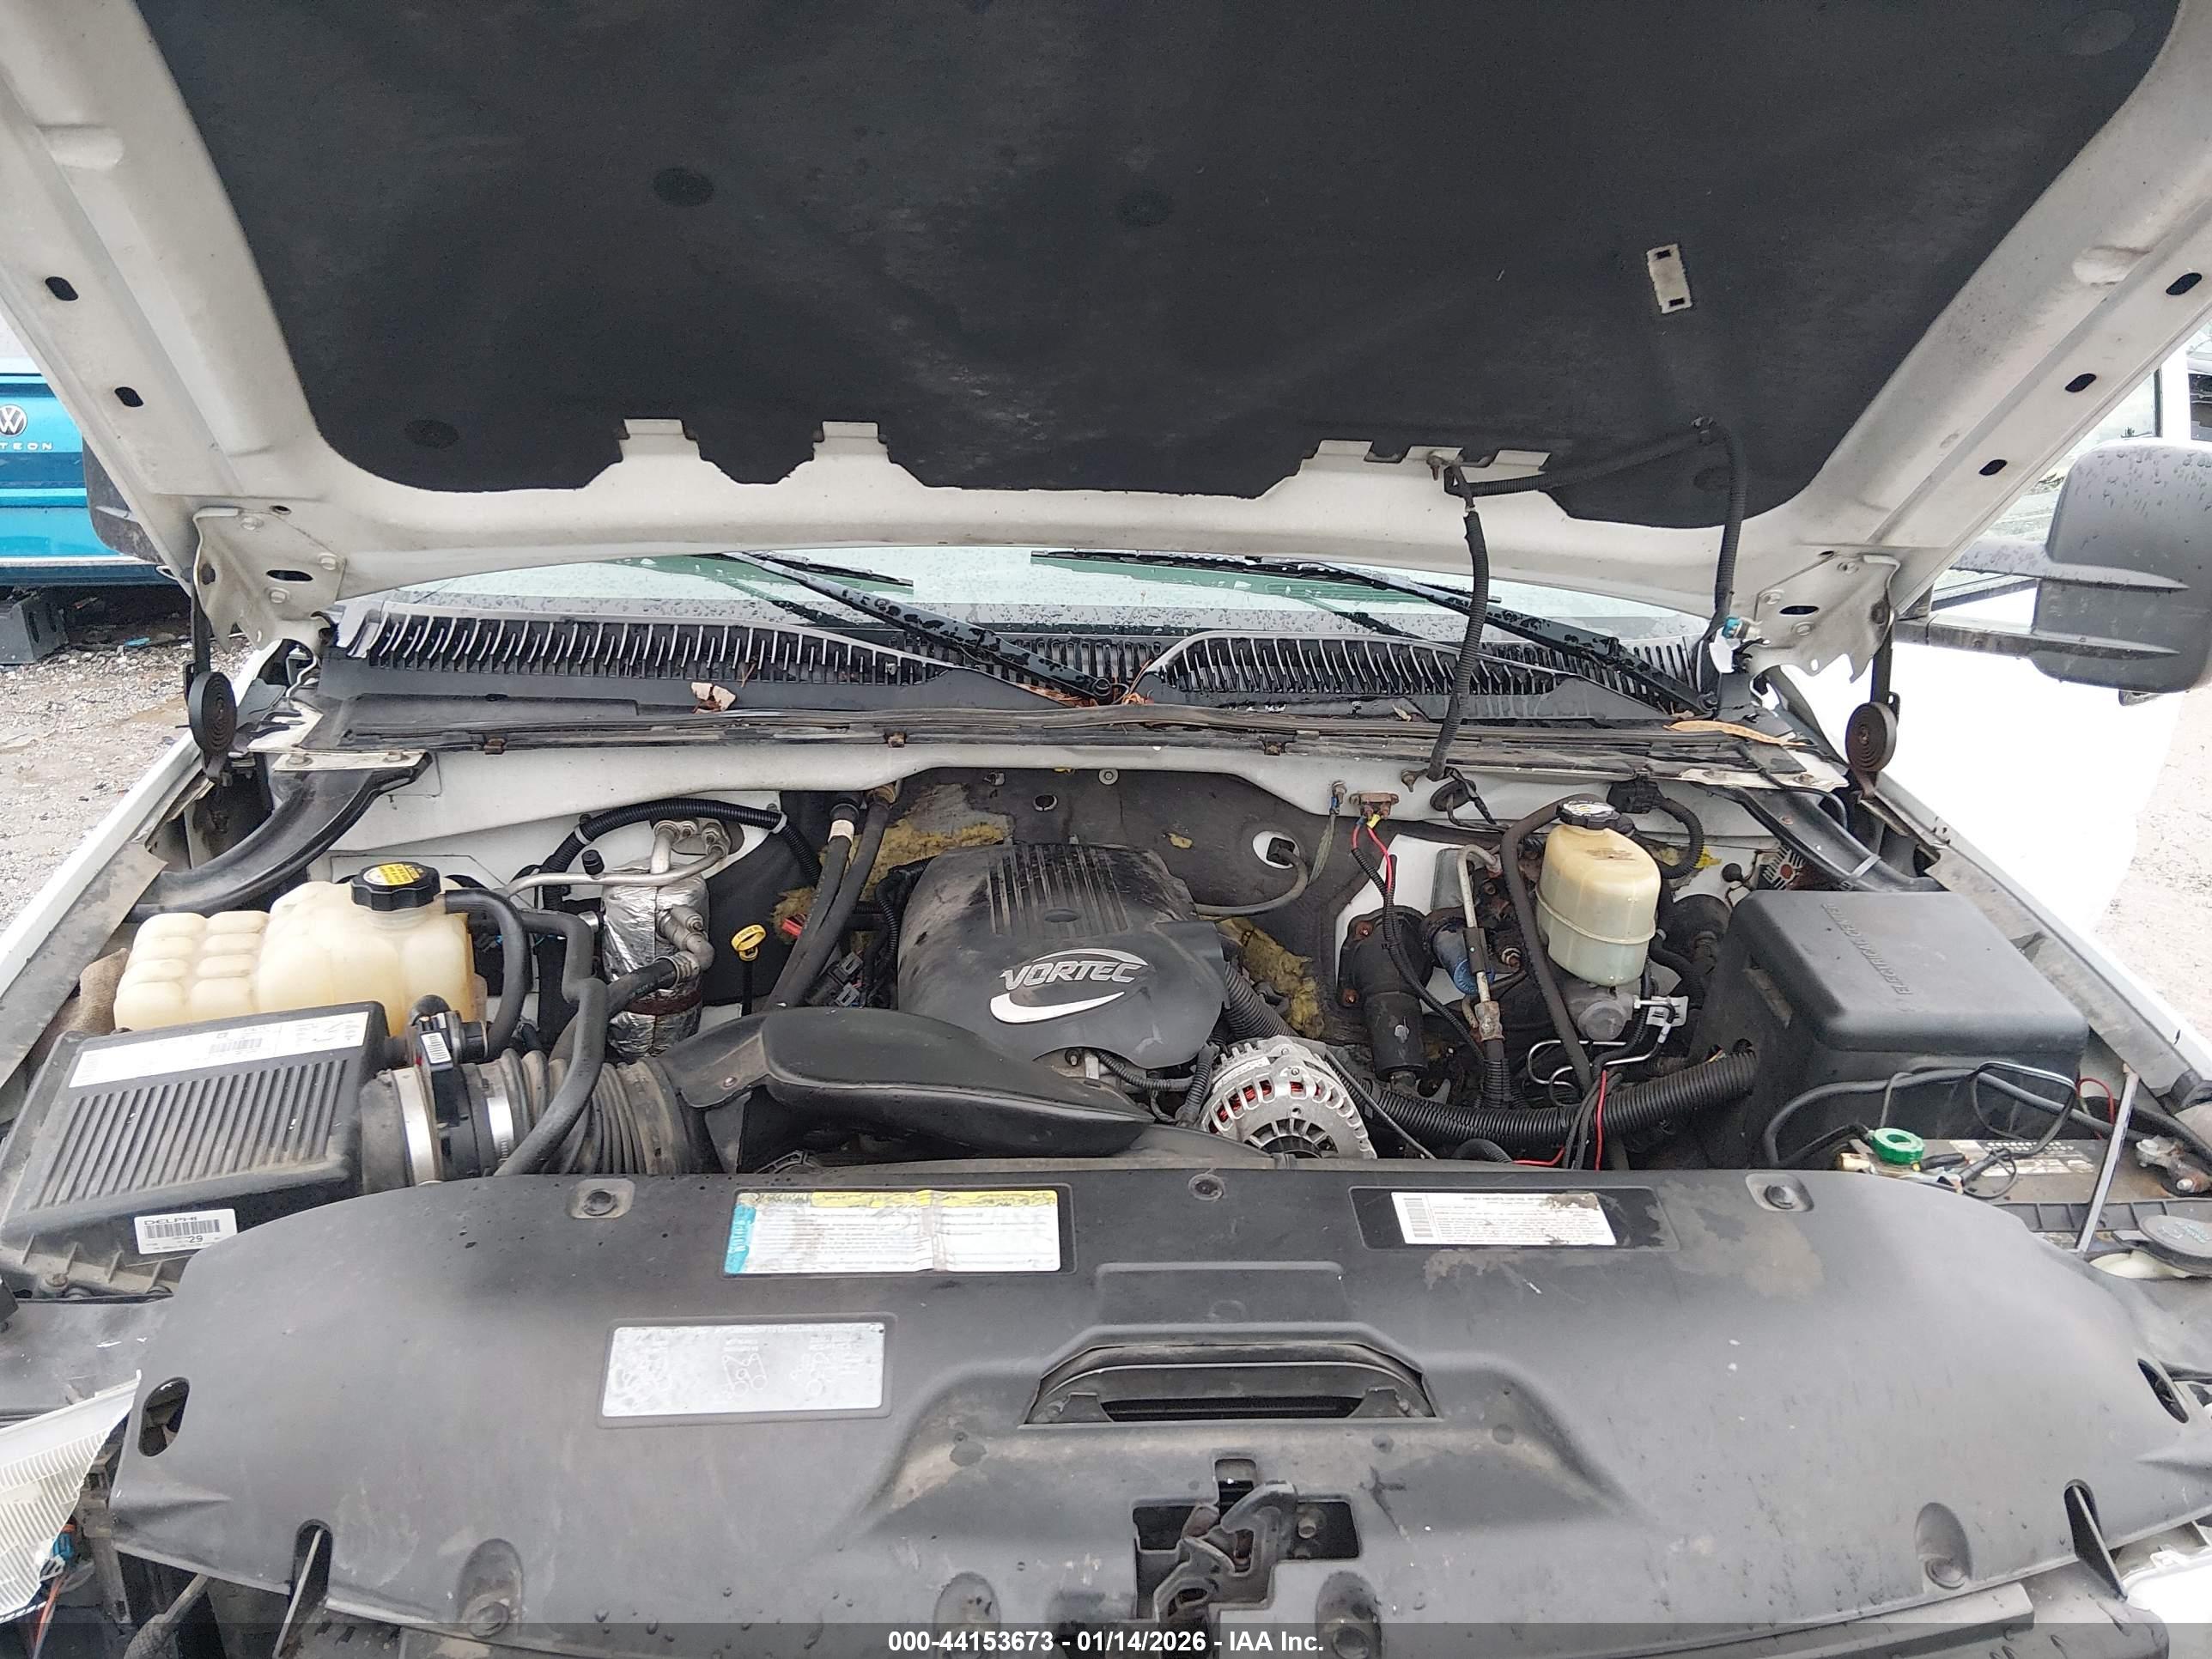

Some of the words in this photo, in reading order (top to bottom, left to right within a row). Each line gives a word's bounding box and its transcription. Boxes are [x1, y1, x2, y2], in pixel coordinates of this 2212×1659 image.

[0, 406, 25, 434] VW
[1820, 903, 1862, 938] CENTER
[1000, 960, 1143, 991] VORTEC
[1852, 939, 1914, 995] ELECTRICAL
[143, 1216, 198, 1225] DELPHI
